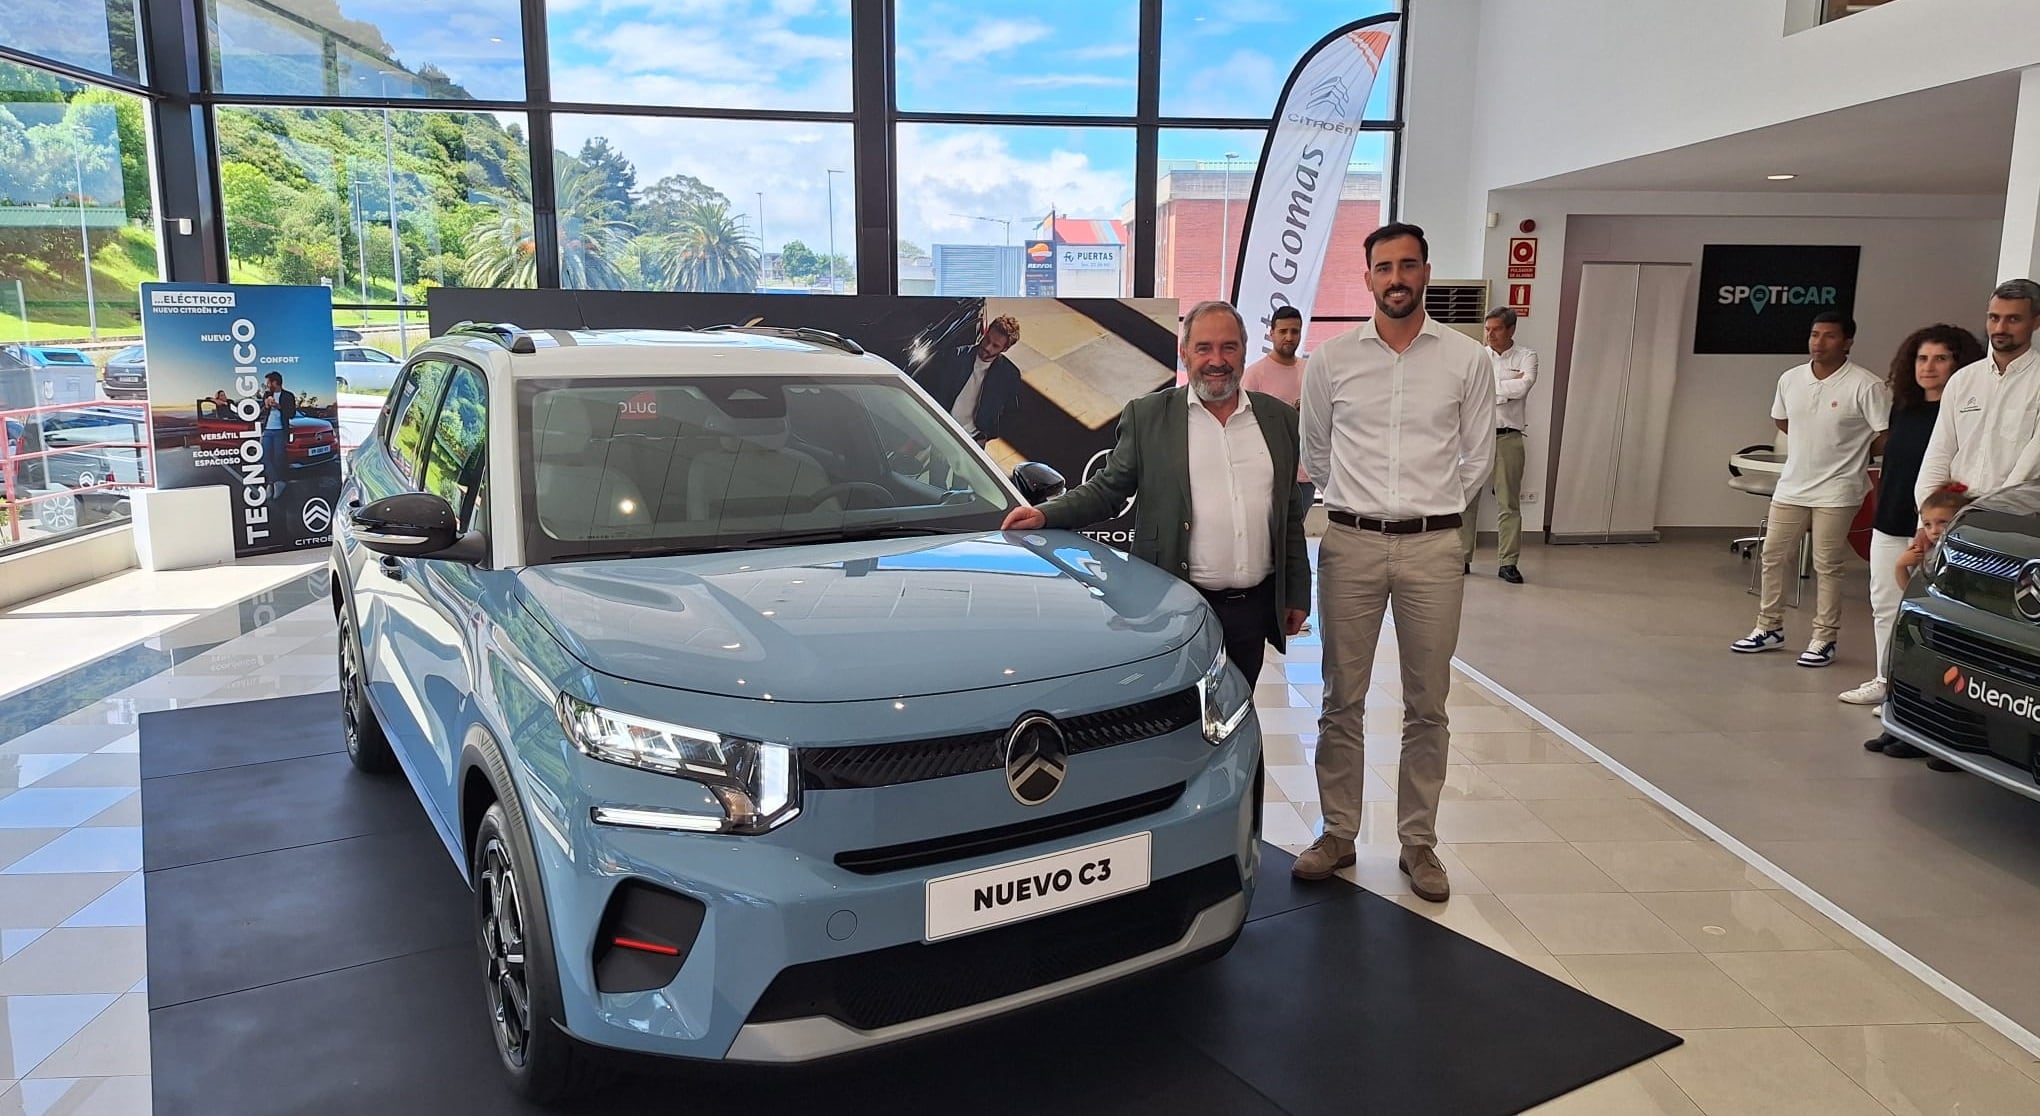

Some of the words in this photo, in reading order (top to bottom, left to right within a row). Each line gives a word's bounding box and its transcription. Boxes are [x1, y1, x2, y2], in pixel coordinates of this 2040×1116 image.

[1269, 144, 1324, 285] Gomas
[1077, 252, 1113, 261] PUERTAS
[180, 306, 212, 314] CITROËN
[260, 356, 300, 364] CONFORT
[230, 318, 270, 545] TECNOLÓGICO
[201, 432, 239, 441] VERSÁTIL
[192, 448, 240, 458] ECOLÓGICO
[195, 458, 241, 467] ESPACIOSO
[974, 868, 1072, 912] NUEVO
[1078, 858, 1112, 886] C3
